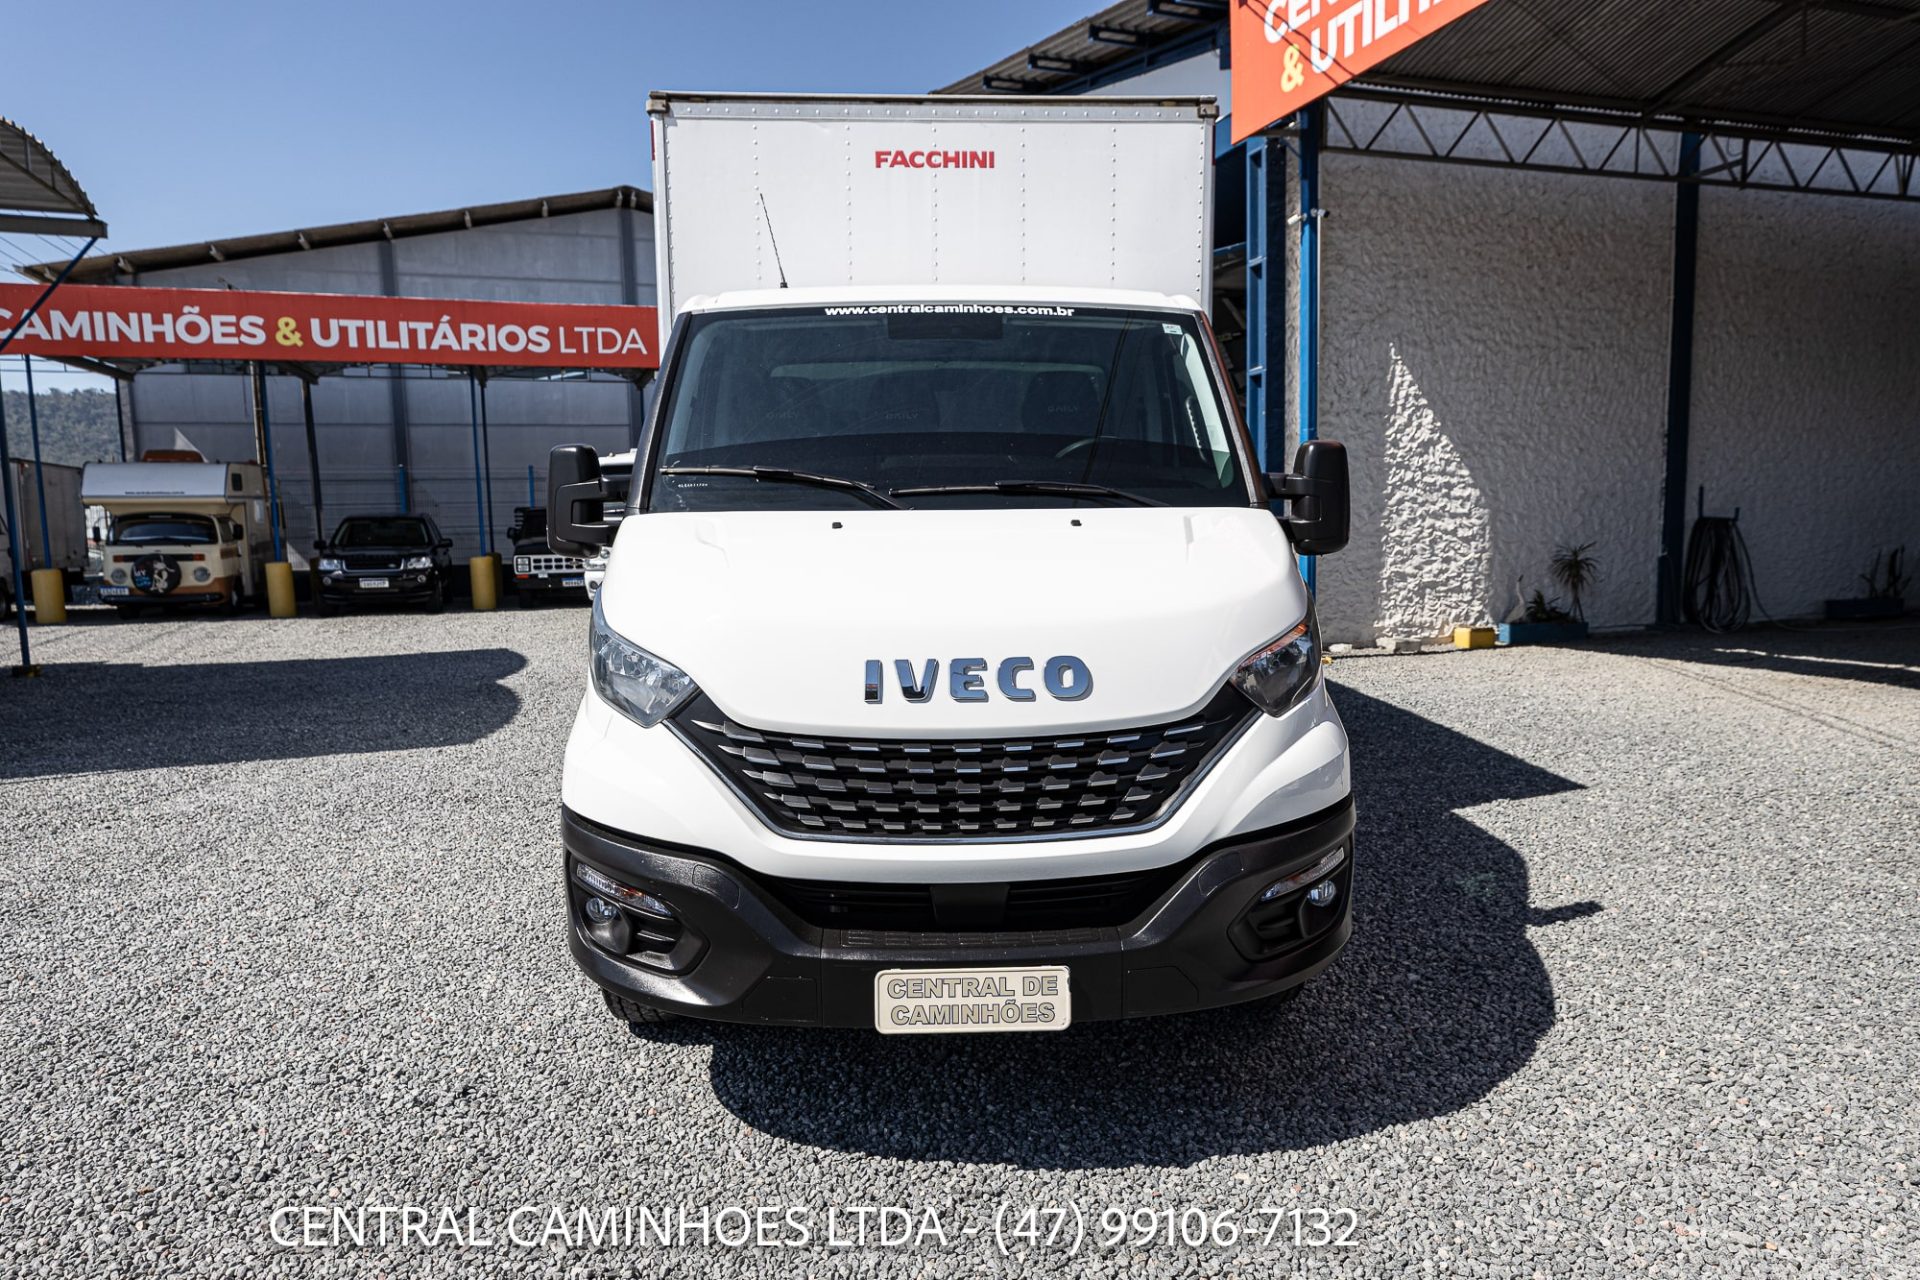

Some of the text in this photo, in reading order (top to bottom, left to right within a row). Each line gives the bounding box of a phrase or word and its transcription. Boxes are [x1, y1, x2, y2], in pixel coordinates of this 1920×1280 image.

[1280, 43, 1305, 93] &
[875, 150, 995, 169] FACCHINI
[824, 303, 1076, 317] www.centralcaminhoes.com.br
[275, 316, 304, 347] &
[310, 314, 551, 354] UTILITÁRIOS
[558, 326, 648, 355] LTDA
[864, 655, 1094, 704] IVECO
[887, 975, 1059, 999] CENTRAL DE
[890, 998, 1056, 1026] CAMINHÕES
